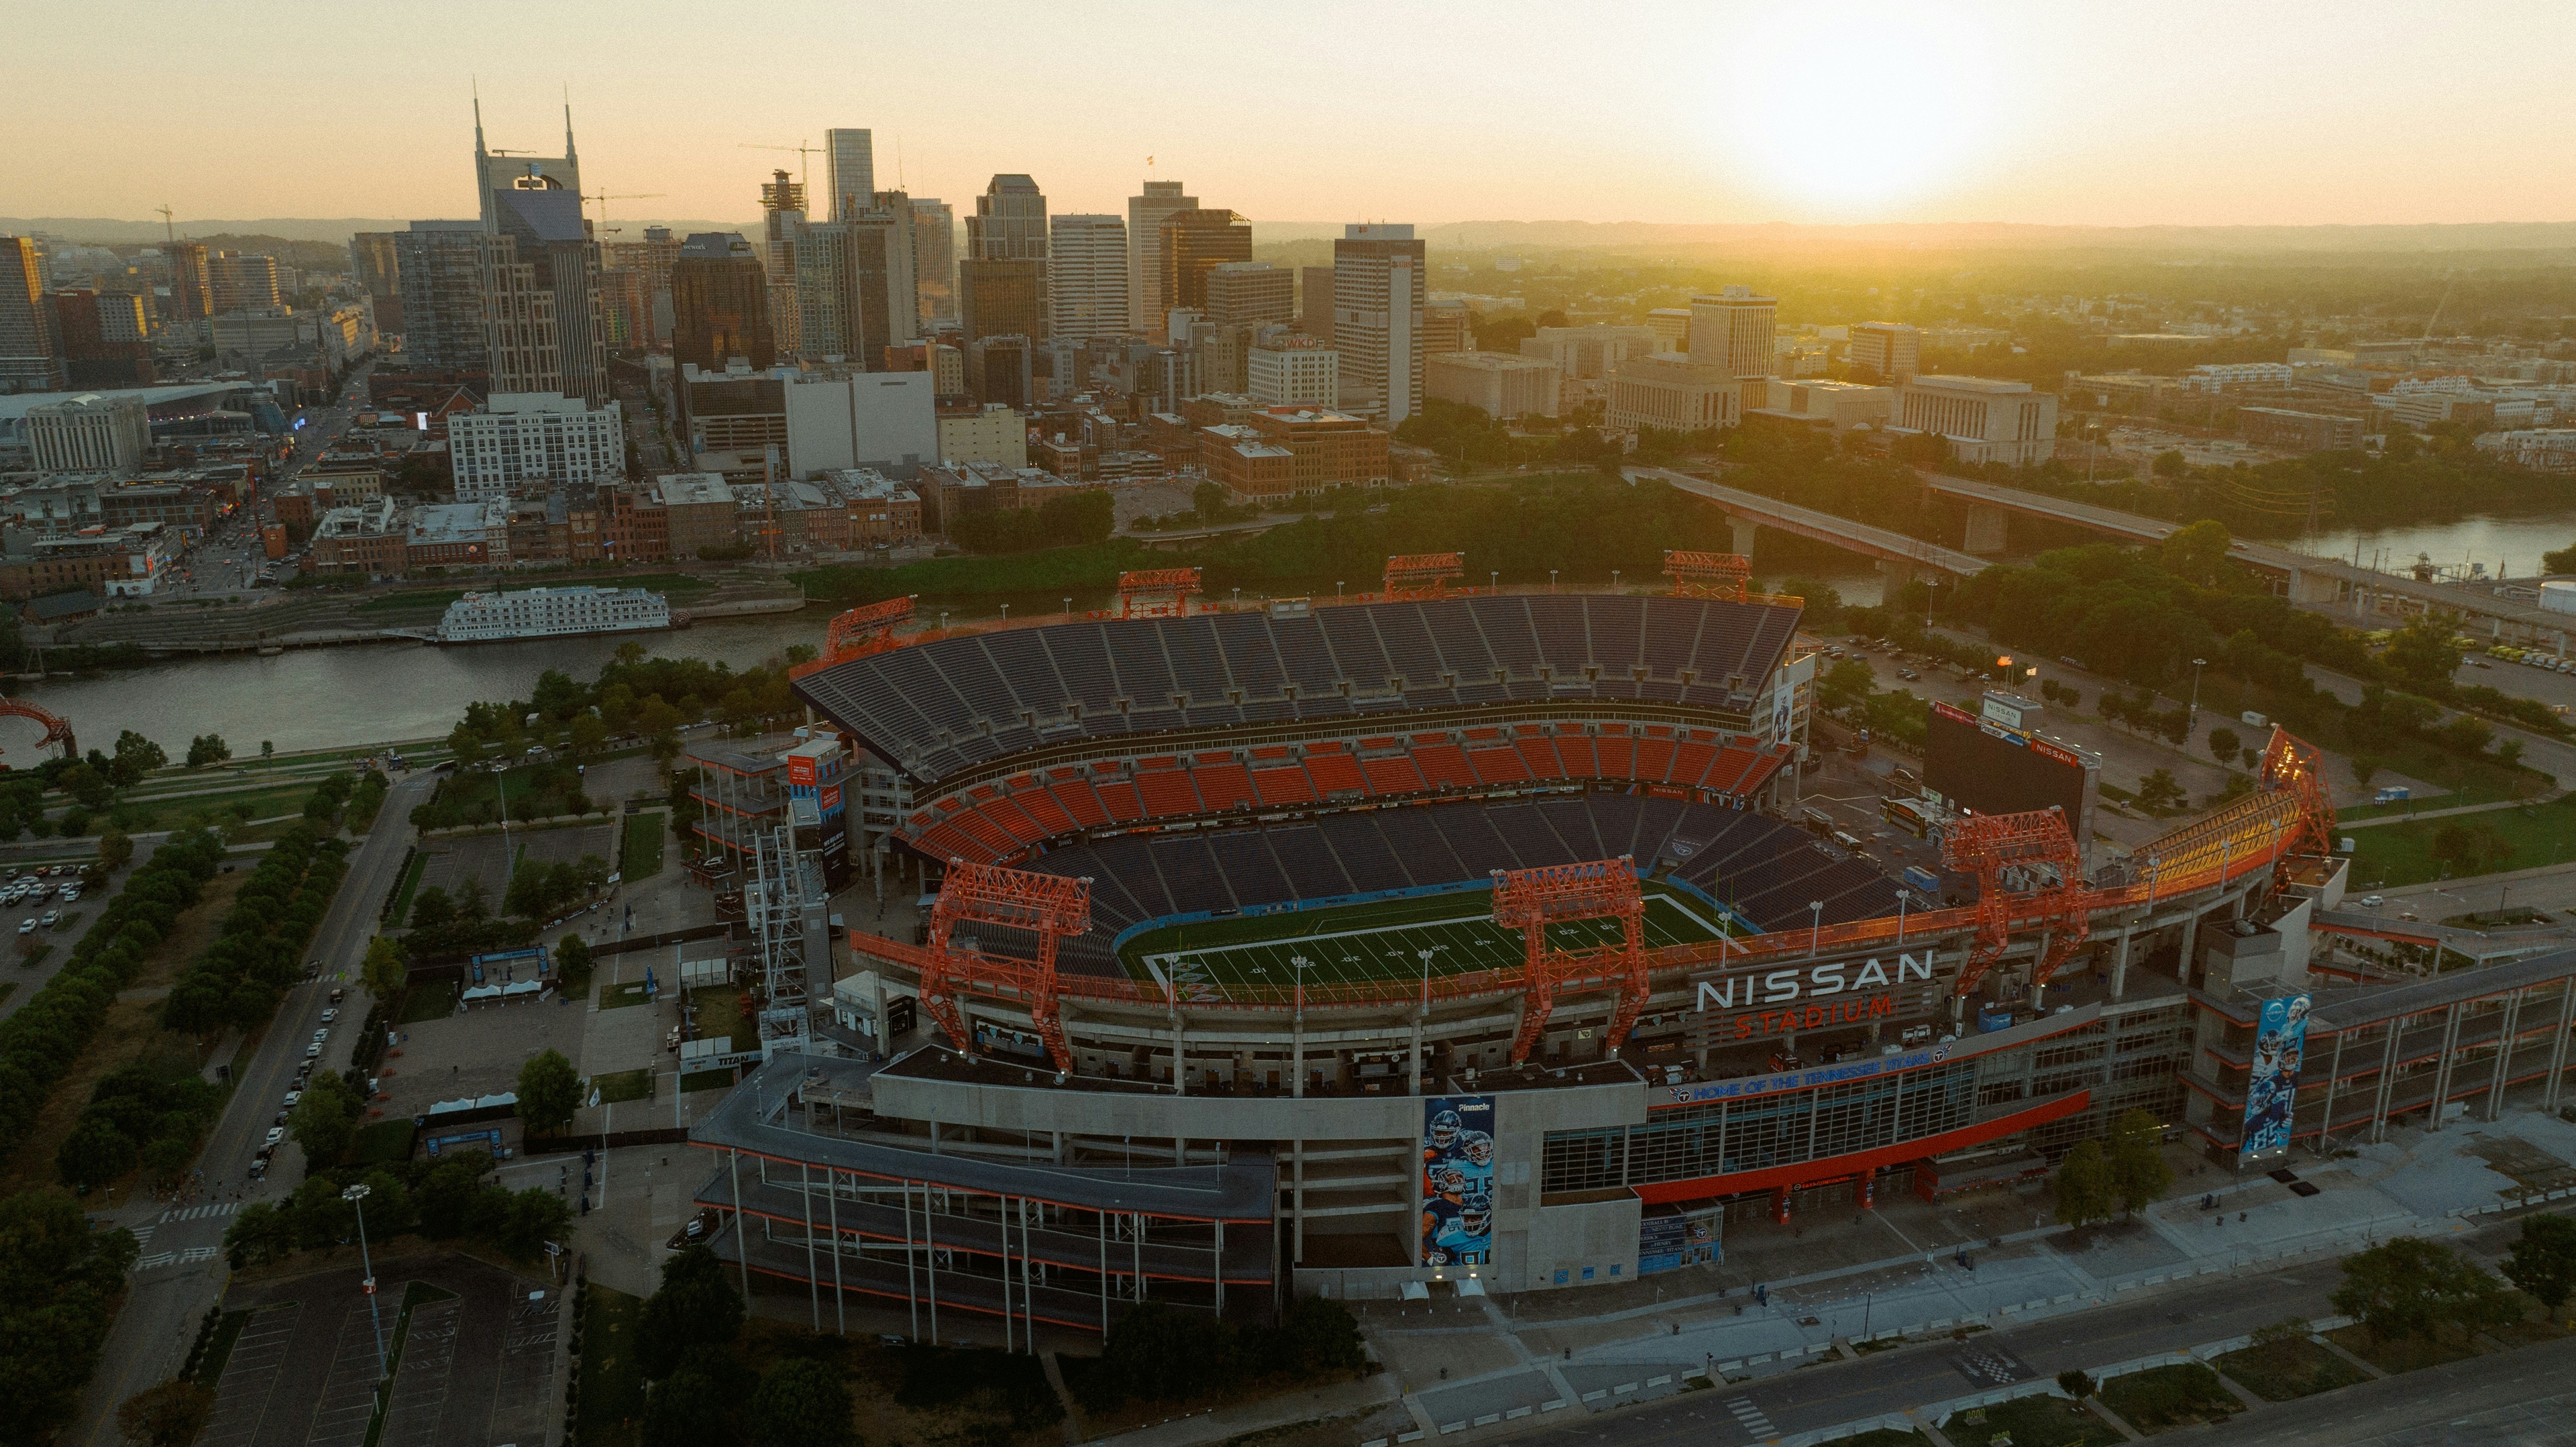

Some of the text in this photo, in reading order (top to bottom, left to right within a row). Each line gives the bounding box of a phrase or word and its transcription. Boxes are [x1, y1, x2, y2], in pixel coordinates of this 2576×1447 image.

[1286, 338, 1324, 349] WKDF
[1988, 703, 2017, 718] NISSAN
[2036, 743, 2072, 763] NISSAN
[1653, 787, 1683, 795] NISSAN
[1673, 839, 1702, 847] NISSAN
[1002, 851, 1026, 864] NISSAN
[1697, 950, 1933, 1012] NISSAN
[1735, 996, 1892, 1038] STADIUM
[1693, 1052, 1930, 1102] HOME OF THE TENNESSEE TITANS
[1458, 1103, 1490, 1112] Pinnacle
